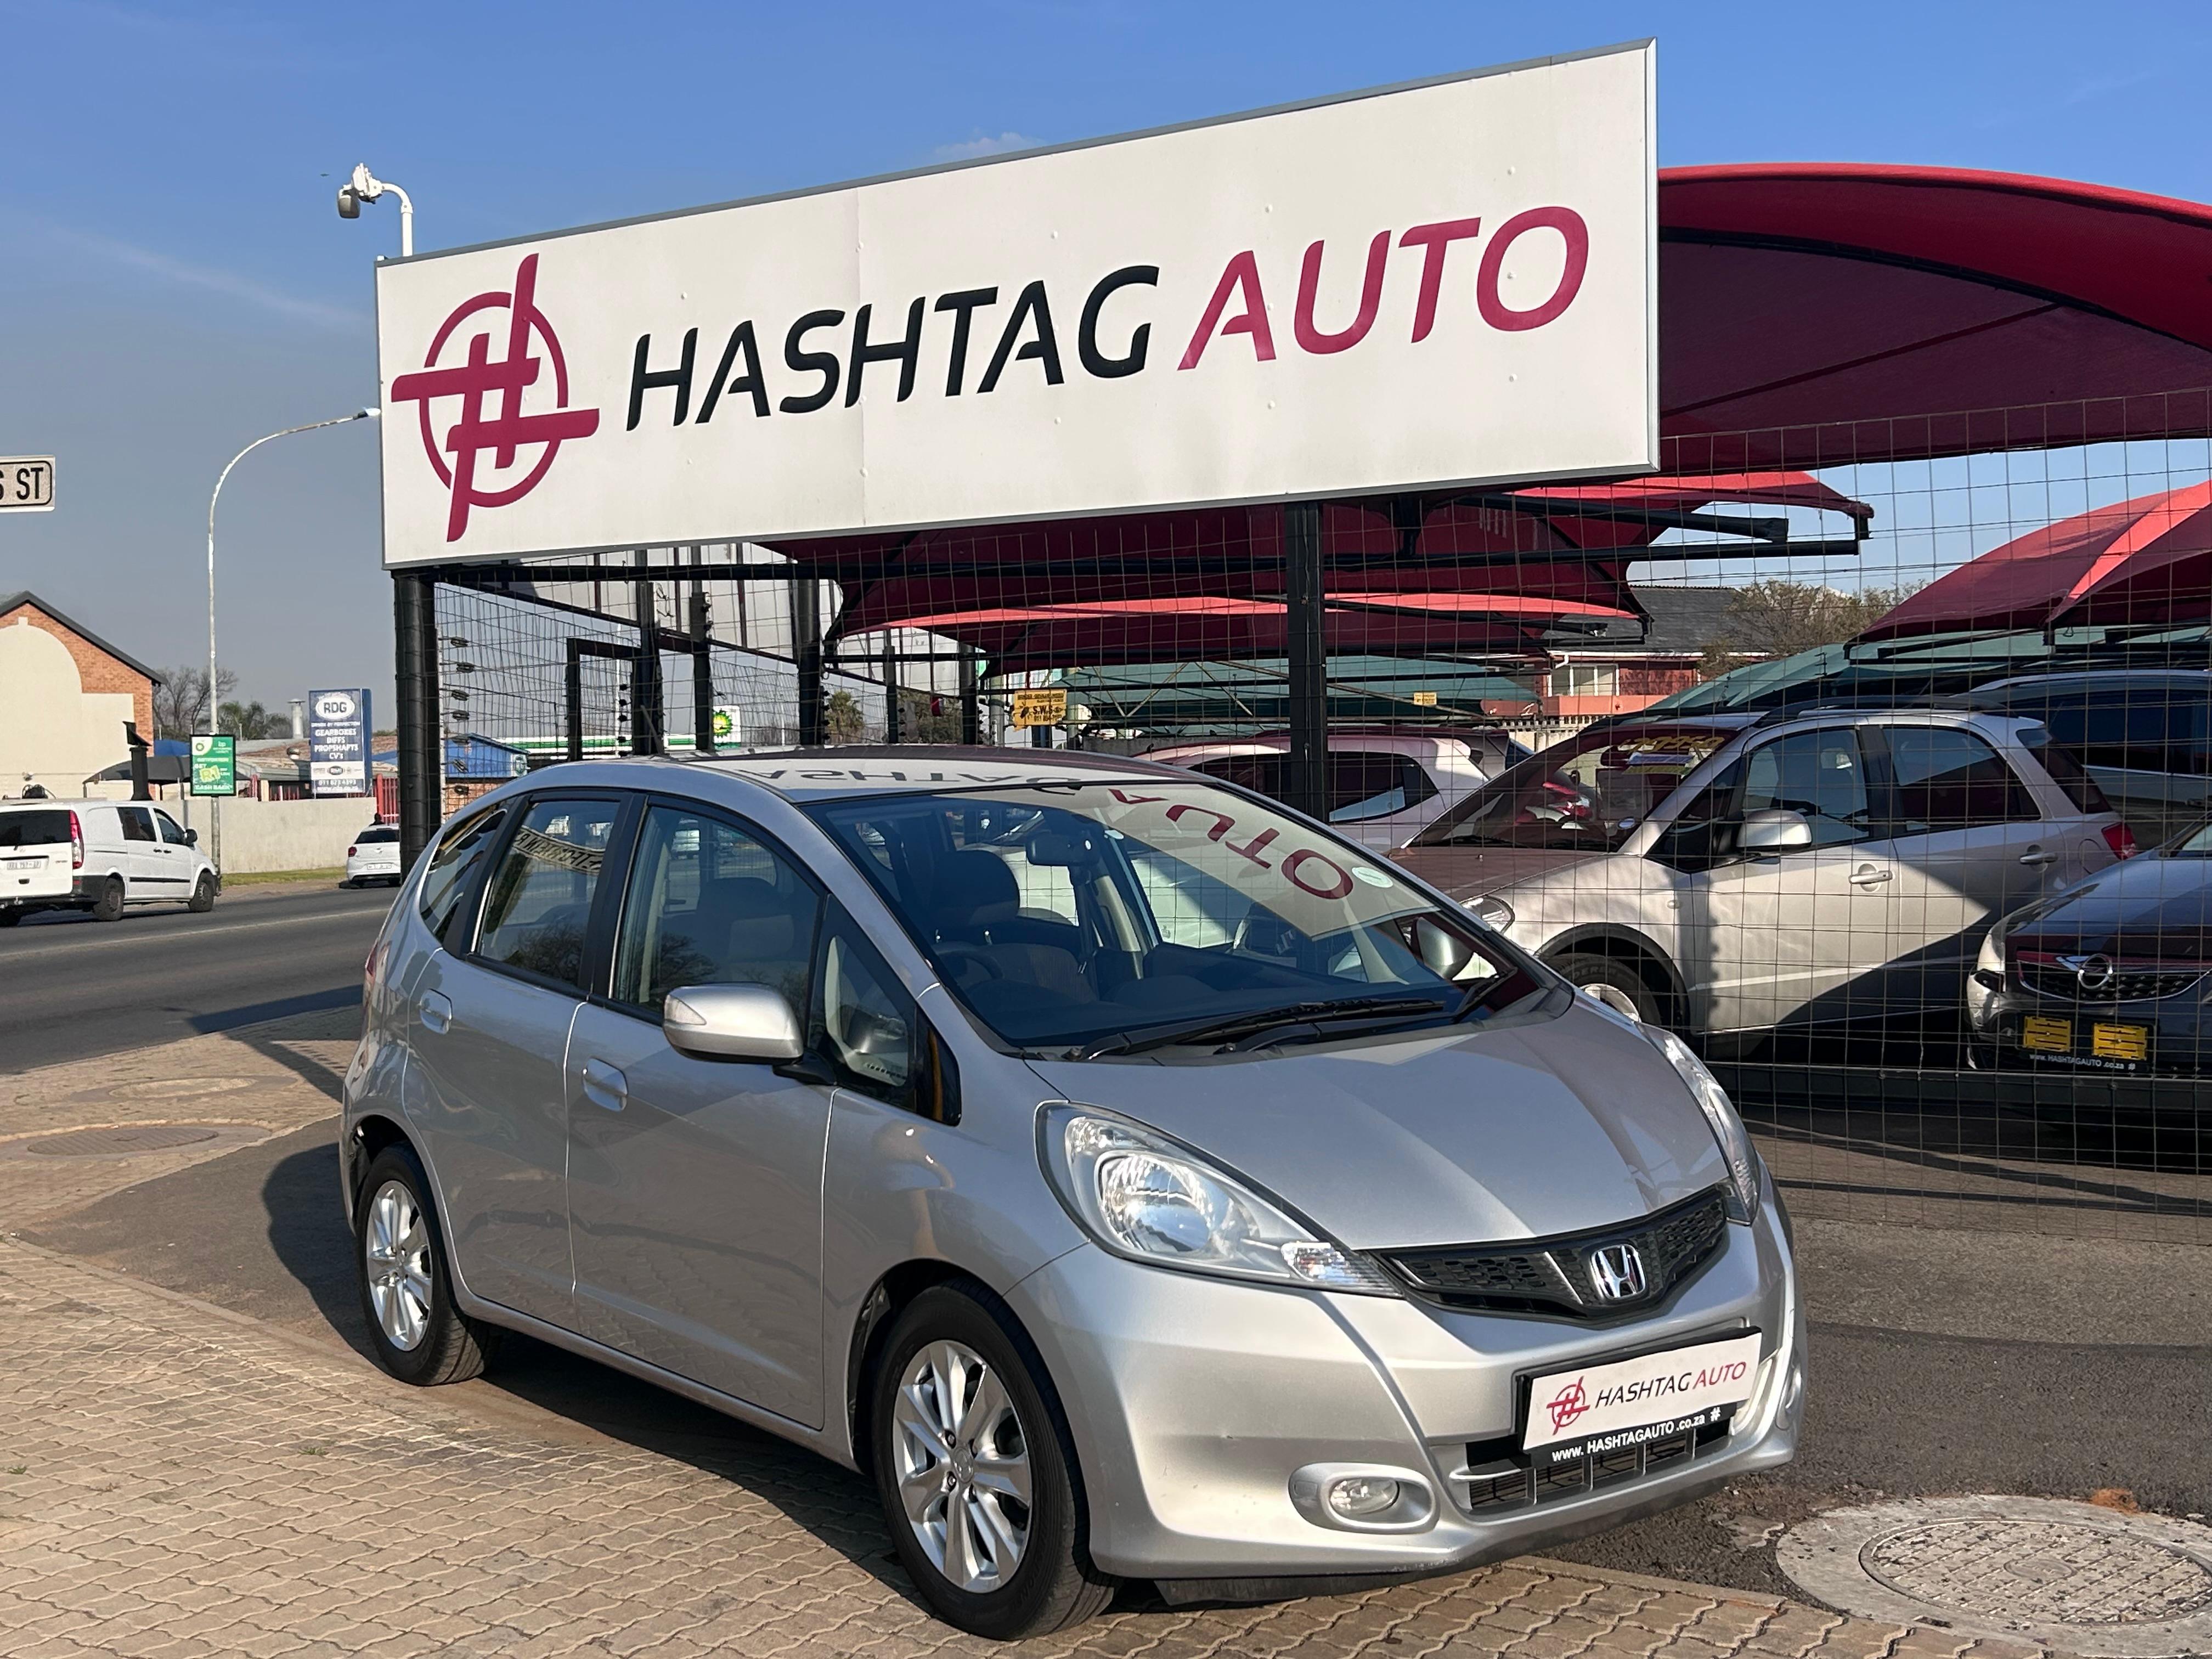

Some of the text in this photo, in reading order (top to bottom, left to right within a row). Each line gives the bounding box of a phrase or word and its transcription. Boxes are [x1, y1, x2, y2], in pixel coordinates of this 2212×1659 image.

[627, 206, 1588, 431] HASHTAG AUTO
[16, 467, 43, 500] ST
[323, 702, 347, 714] RDG
[314, 744, 359, 752] PROPSHAFTS
[315, 729, 357, 737] GEARBOXES
[1595, 1361, 1747, 1409] HASHTAG AUTO
[1587, 1421, 1674, 1454] HASHTAGAUTO
